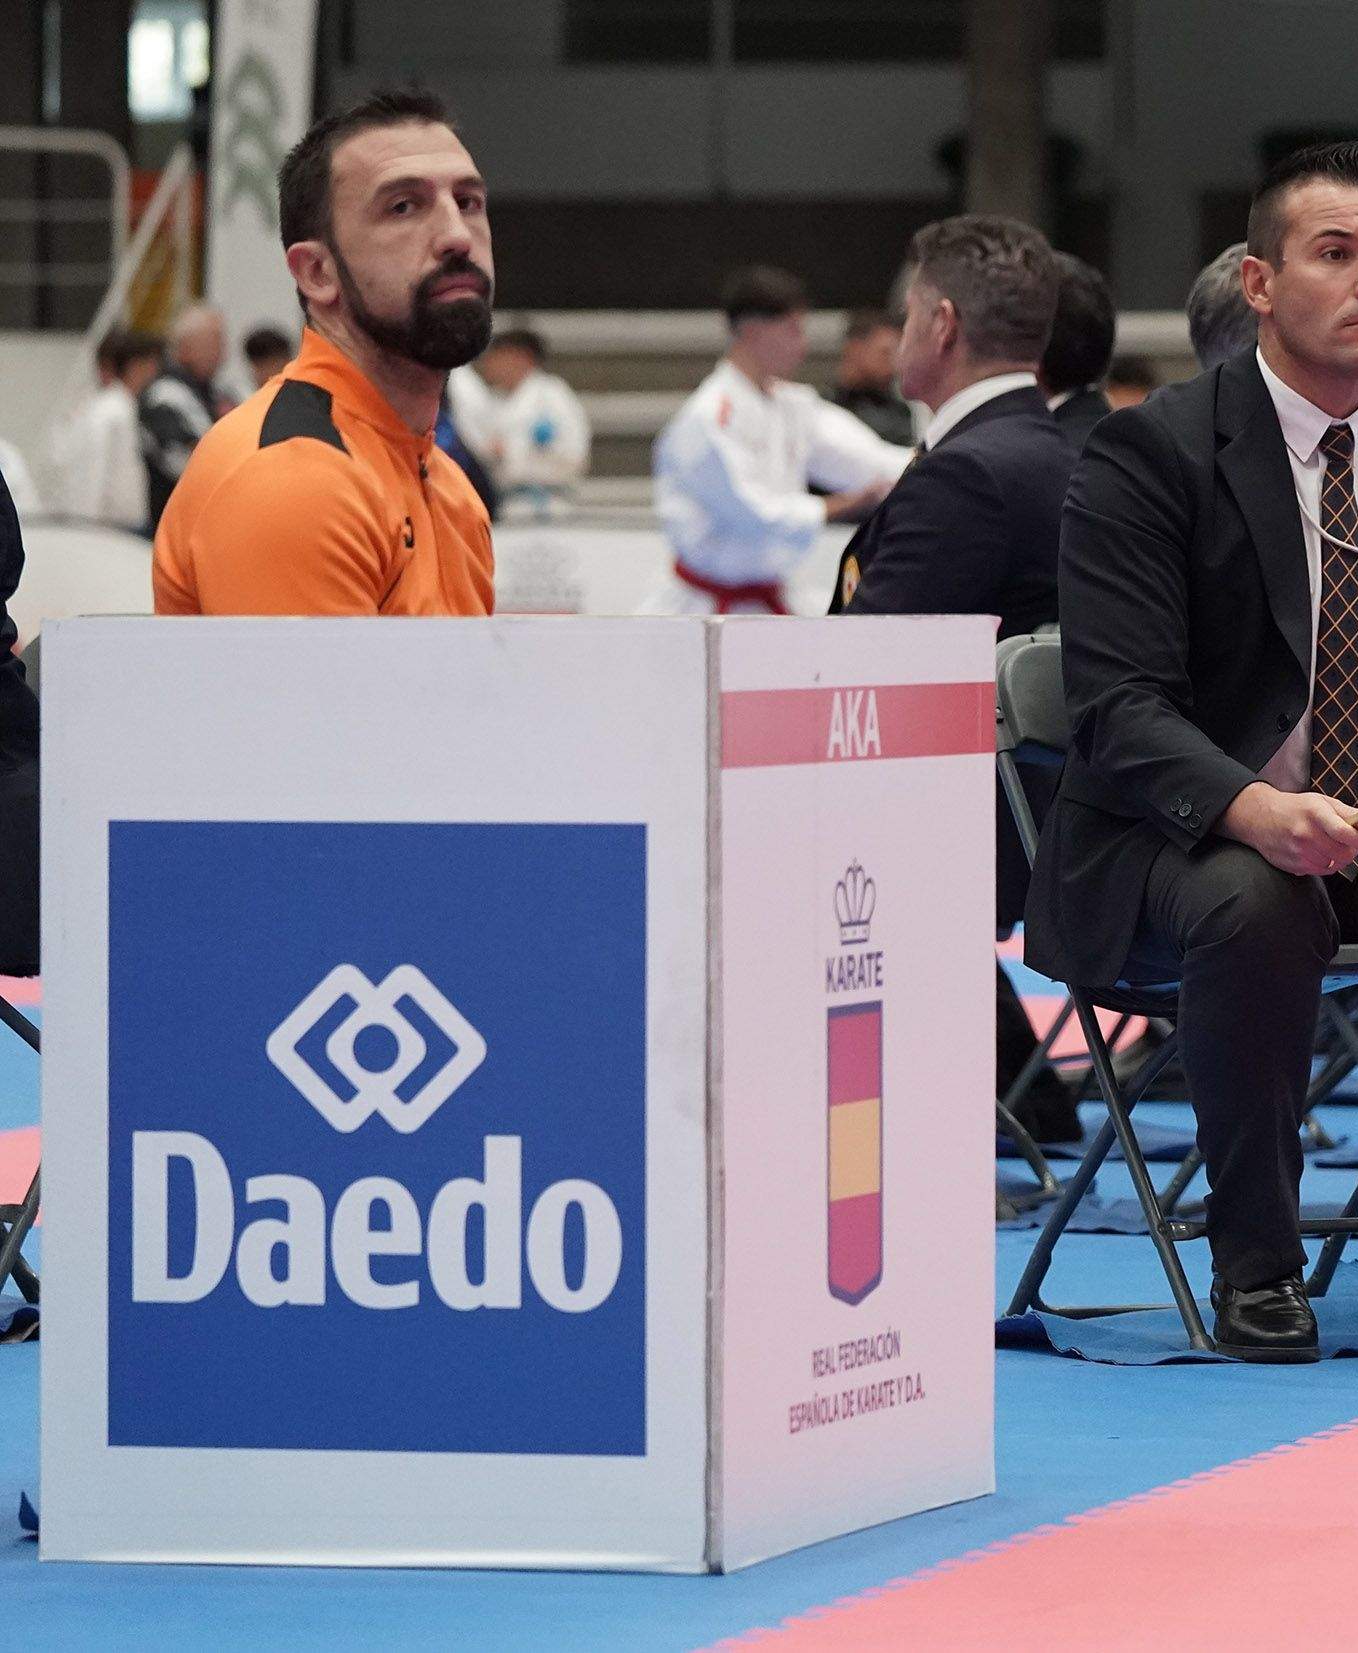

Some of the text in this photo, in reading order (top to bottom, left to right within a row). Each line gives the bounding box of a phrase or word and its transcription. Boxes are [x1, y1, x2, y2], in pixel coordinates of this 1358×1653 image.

[827, 689, 881, 758] AKA
[825, 951, 883, 993] KARATE
[132, 1131, 622, 1313] Daedo
[812, 1326, 901, 1378] REAL FEDERACIÓN
[789, 1393, 840, 1434] ESPAÑOLA
[842, 1389, 854, 1419] DE
[857, 1379, 895, 1415] KARATE
[896, 1376, 904, 1405] Y
